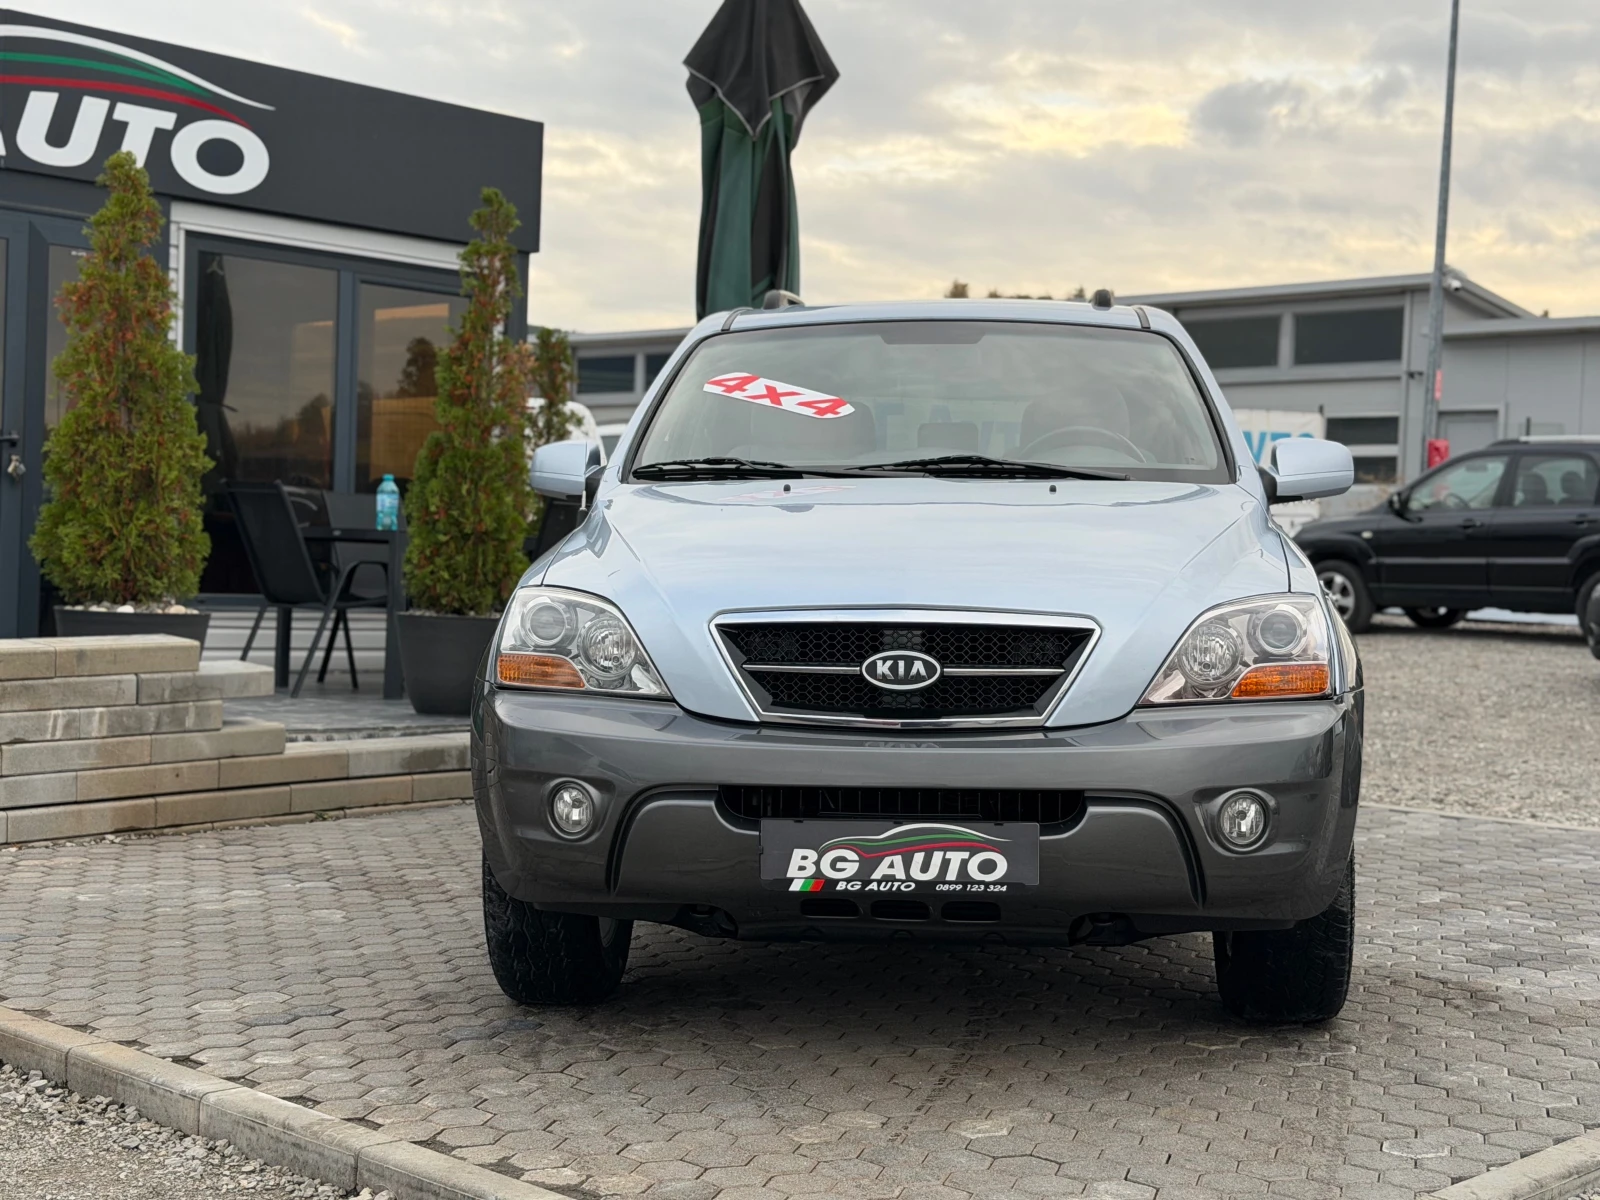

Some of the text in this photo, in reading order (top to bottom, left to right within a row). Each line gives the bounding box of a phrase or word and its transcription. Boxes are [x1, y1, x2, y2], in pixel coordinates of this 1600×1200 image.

[0, 90, 270, 194] UTO
[875, 659, 928, 680] KIA
[786, 848, 1008, 882] BG AUTO
[835, 881, 862, 891] BG
[865, 881, 916, 892] AUTO
[935, 883, 962, 892] 0899
[966, 884, 984, 892] 123
